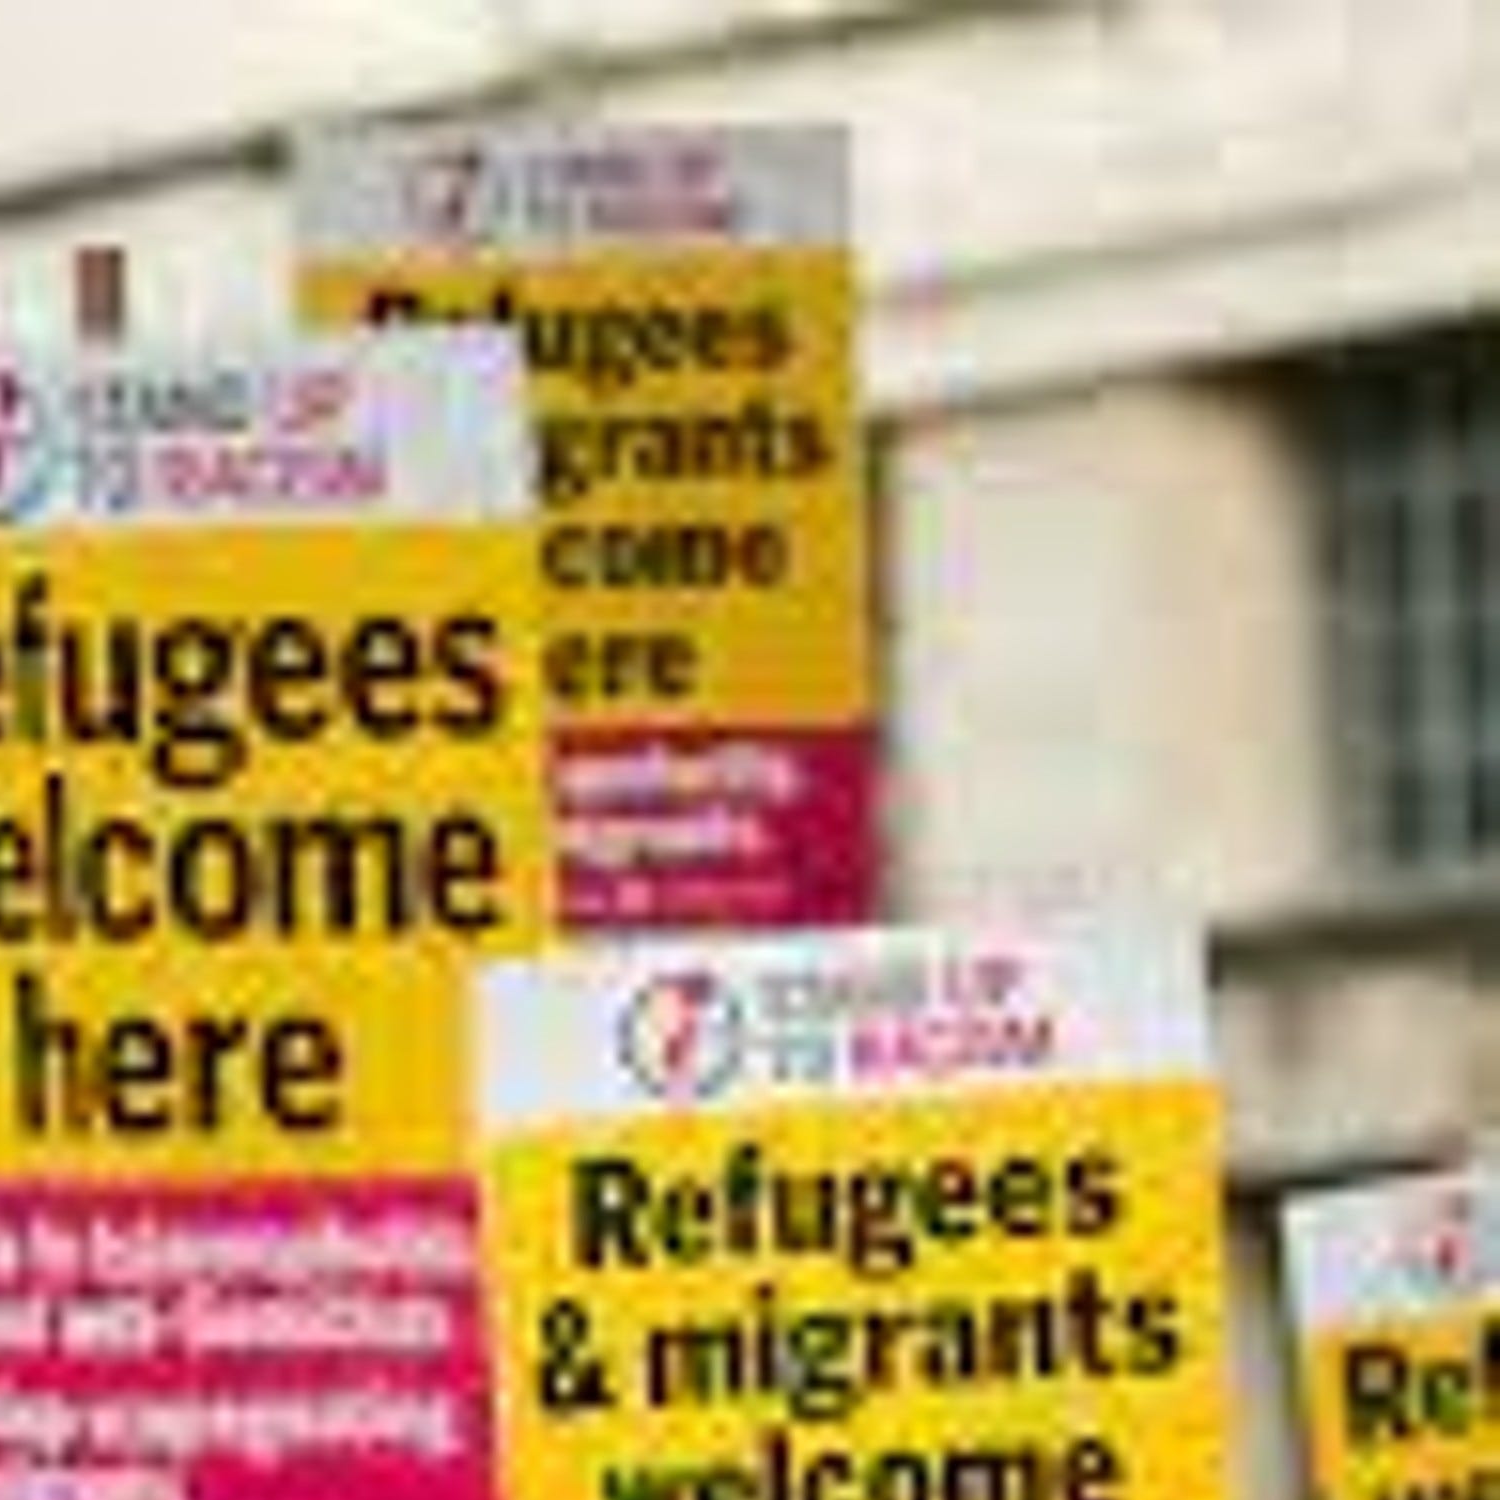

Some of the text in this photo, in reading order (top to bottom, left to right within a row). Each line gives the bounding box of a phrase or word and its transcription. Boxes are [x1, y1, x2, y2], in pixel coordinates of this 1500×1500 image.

[536, 400, 838, 511] grants
[542, 523, 790, 590] come
[544, 633, 698, 700] ere
[14, 970, 343, 1136] here
[573, 1143, 1124, 1280] Refugees
[537, 1299, 615, 1415] &
[647, 1271, 1182, 1421] migrants
